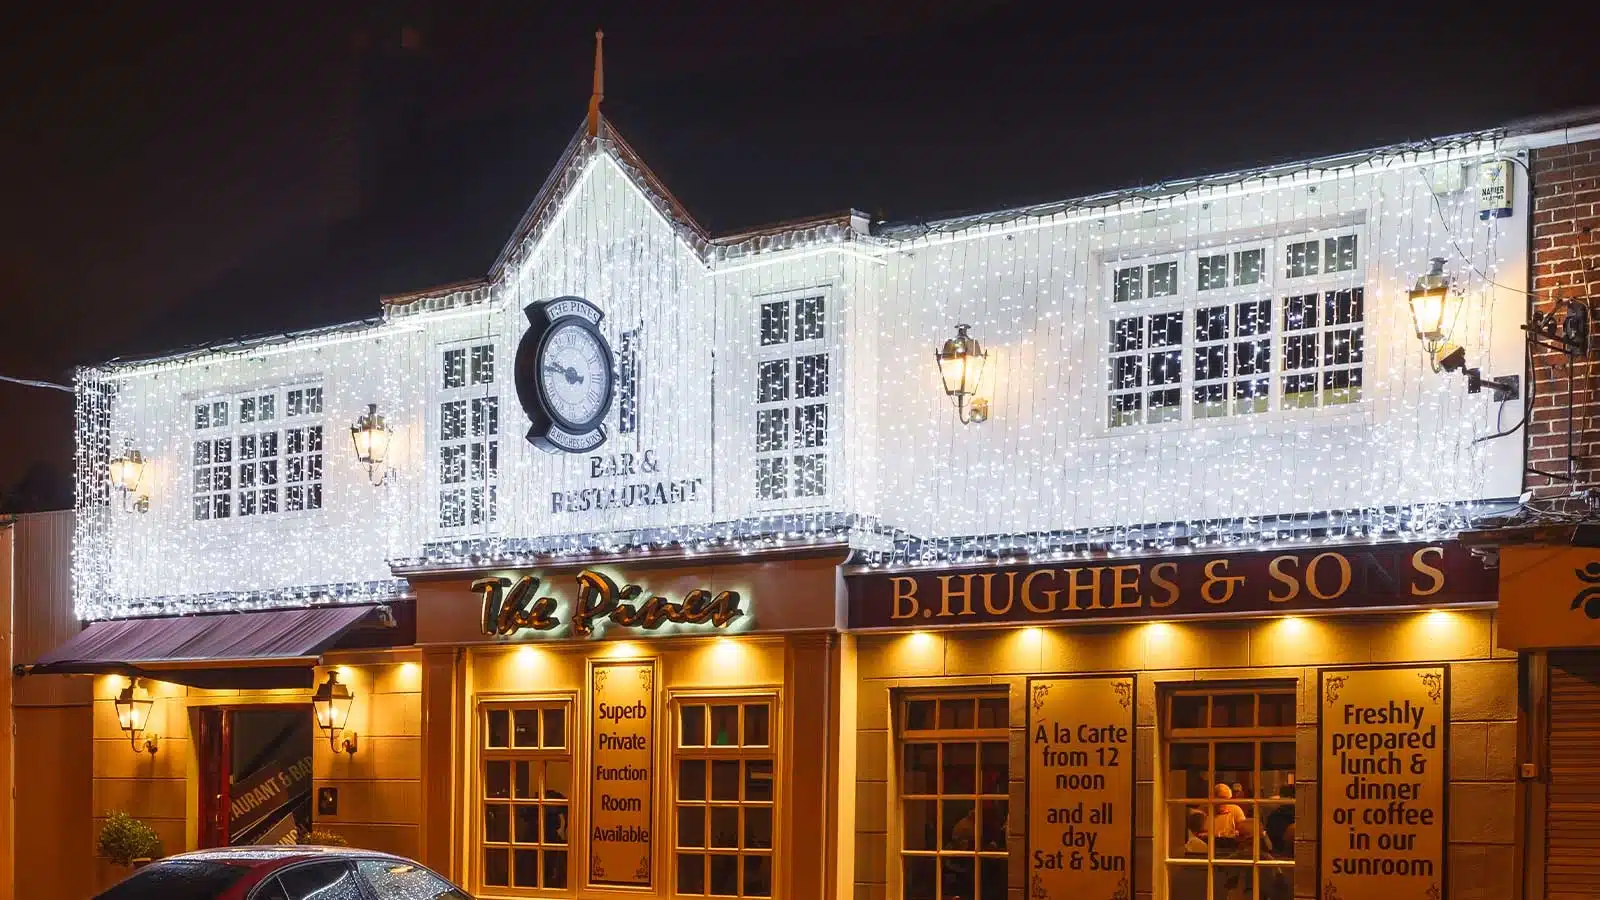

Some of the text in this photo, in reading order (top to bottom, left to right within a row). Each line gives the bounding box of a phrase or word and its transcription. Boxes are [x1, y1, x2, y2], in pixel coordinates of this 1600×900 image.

[550, 301, 599, 323] THE PINES
[590, 450, 660, 478] BAR &
[551, 478, 702, 514] RESTAURANT
[1200, 559, 1245, 603] &
[470, 569, 745, 637] The Pines
[599, 700, 647, 724] Superb
[1344, 700, 1425, 729] Freshly
[599, 732, 646, 750] Private
[1054, 722, 1071, 743] la
[1077, 724, 1128, 743] Carte
[1332, 725, 1436, 756] prepared
[1043, 746, 1119, 767] from 12
[1340, 751, 1428, 775] lunch &
[596, 765, 648, 781] Function
[1056, 774, 1105, 790] noon
[231, 776, 281, 821] AURANT
[278, 771, 293, 787] &
[1345, 776, 1421, 800] dinner
[601, 794, 641, 812] Room
[1047, 802, 1113, 825] and all
[1333, 801, 1434, 826] or coffee
[593, 826, 649, 843] Available
[1062, 825, 1097, 852] day
[1349, 827, 1417, 850] in our
[1033, 849, 1126, 871] Sat & Sun
[1332, 857, 1434, 876] sunroom
